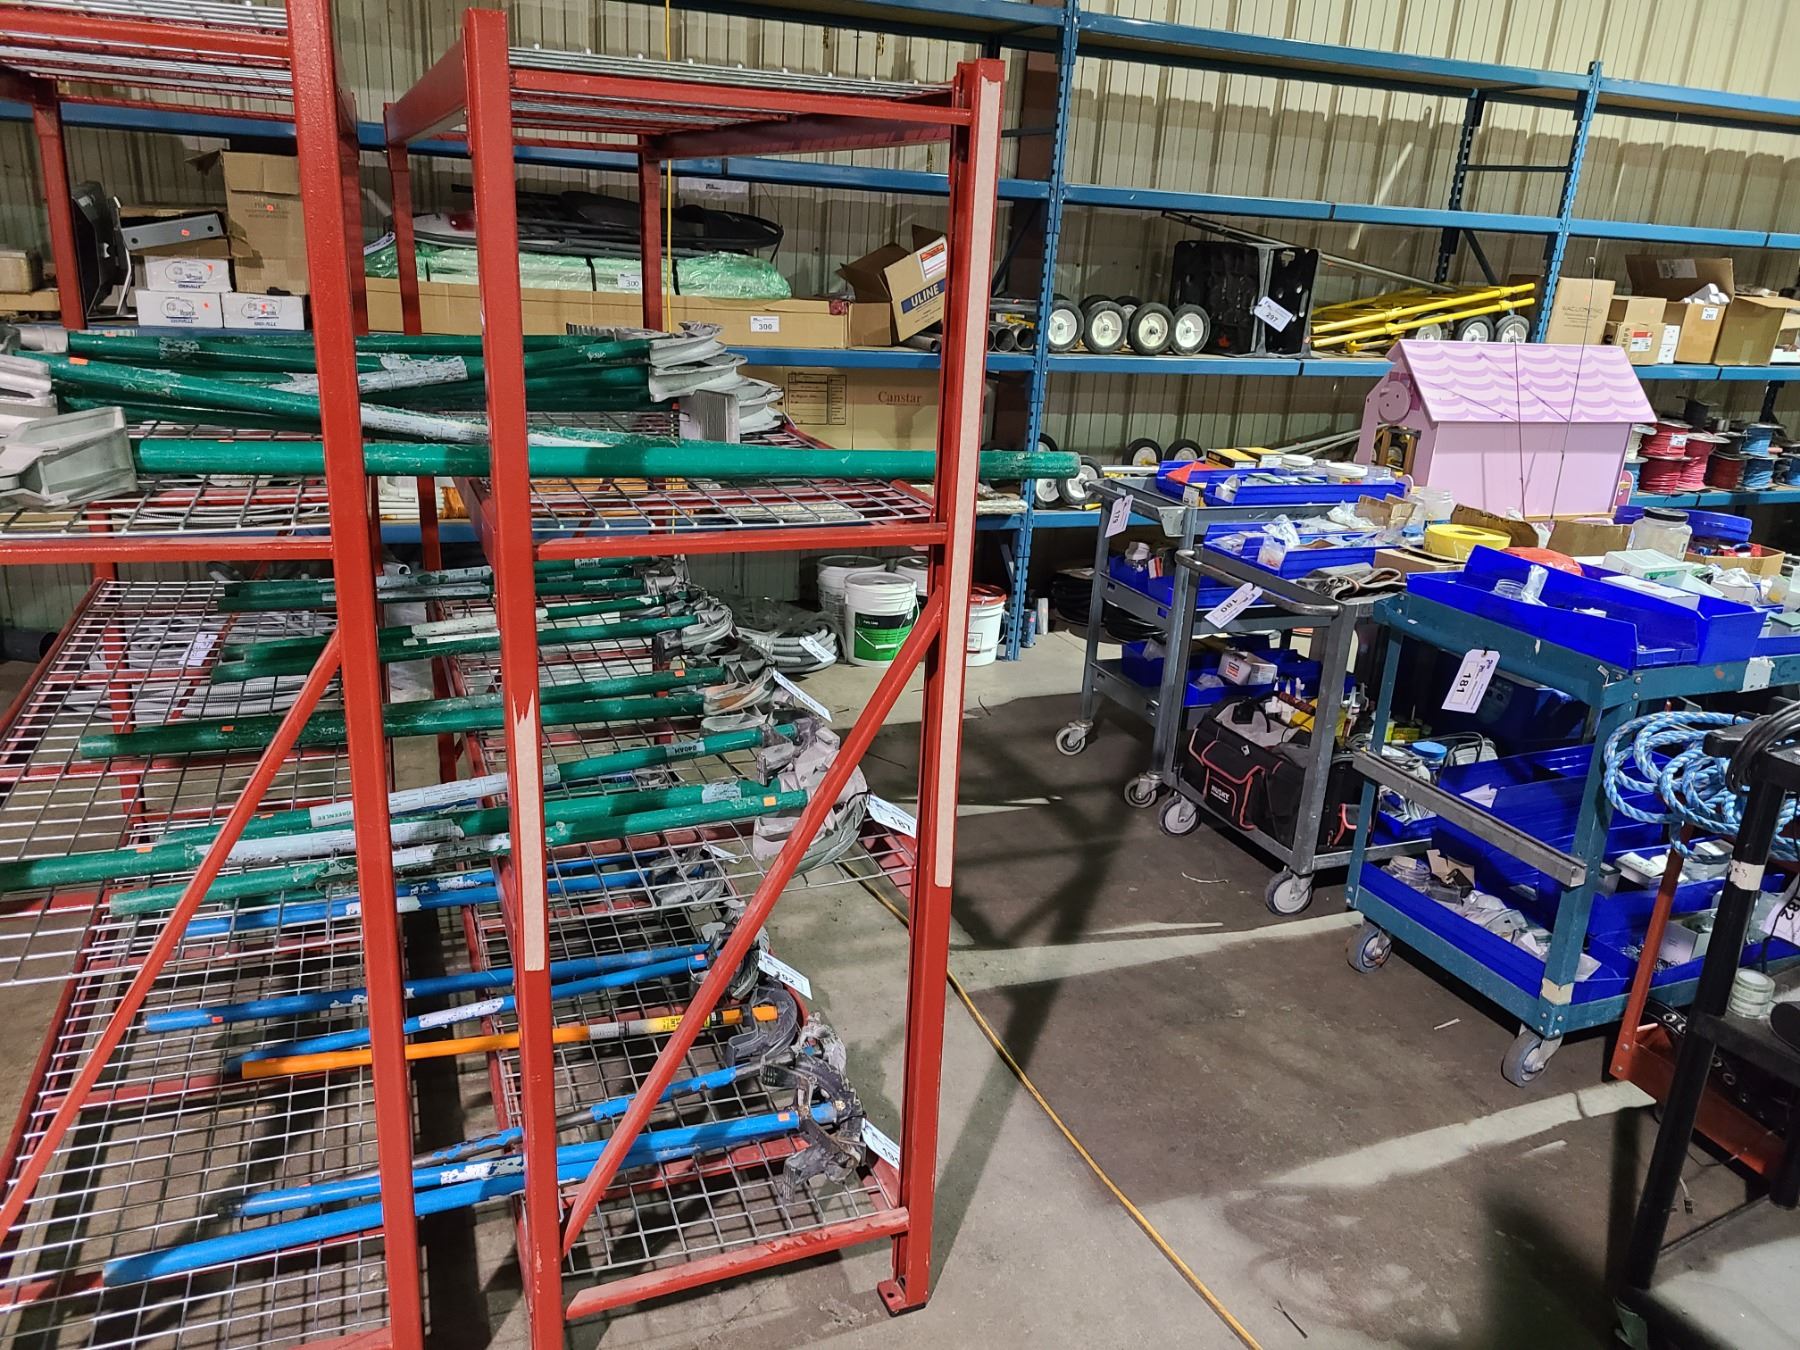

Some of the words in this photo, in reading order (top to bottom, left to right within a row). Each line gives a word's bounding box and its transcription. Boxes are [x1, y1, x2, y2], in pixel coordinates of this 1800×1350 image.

[626, 280, 640, 288] 300
[911, 283, 940, 307] ULINE
[1266, 312, 1279, 322] 297
[878, 391, 923, 404] Canstar
[1220, 599, 1238, 613] 180
[1455, 672, 1472, 693] 181
[890, 816, 911, 831] 187
